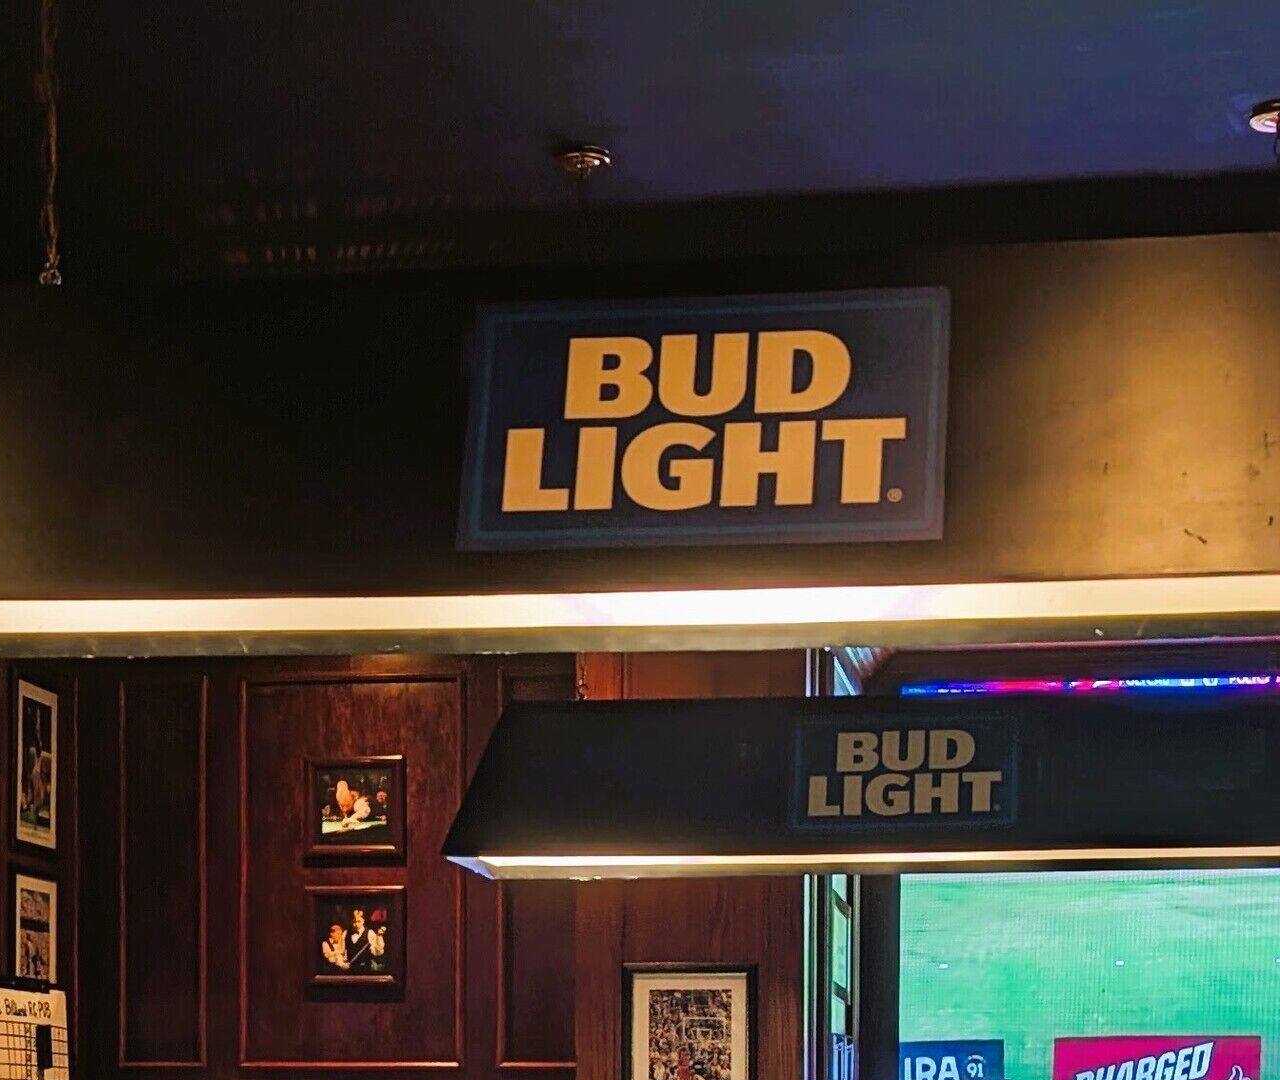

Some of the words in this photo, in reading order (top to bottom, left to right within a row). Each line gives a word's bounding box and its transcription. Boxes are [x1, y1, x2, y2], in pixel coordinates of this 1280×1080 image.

[564, 330, 851, 420] BUD
[502, 418, 907, 512] LIGHT
[836, 729, 976, 772] BUD
[807, 771, 1002, 817] LIGHT
[966, 1062, 984, 1078] 91
